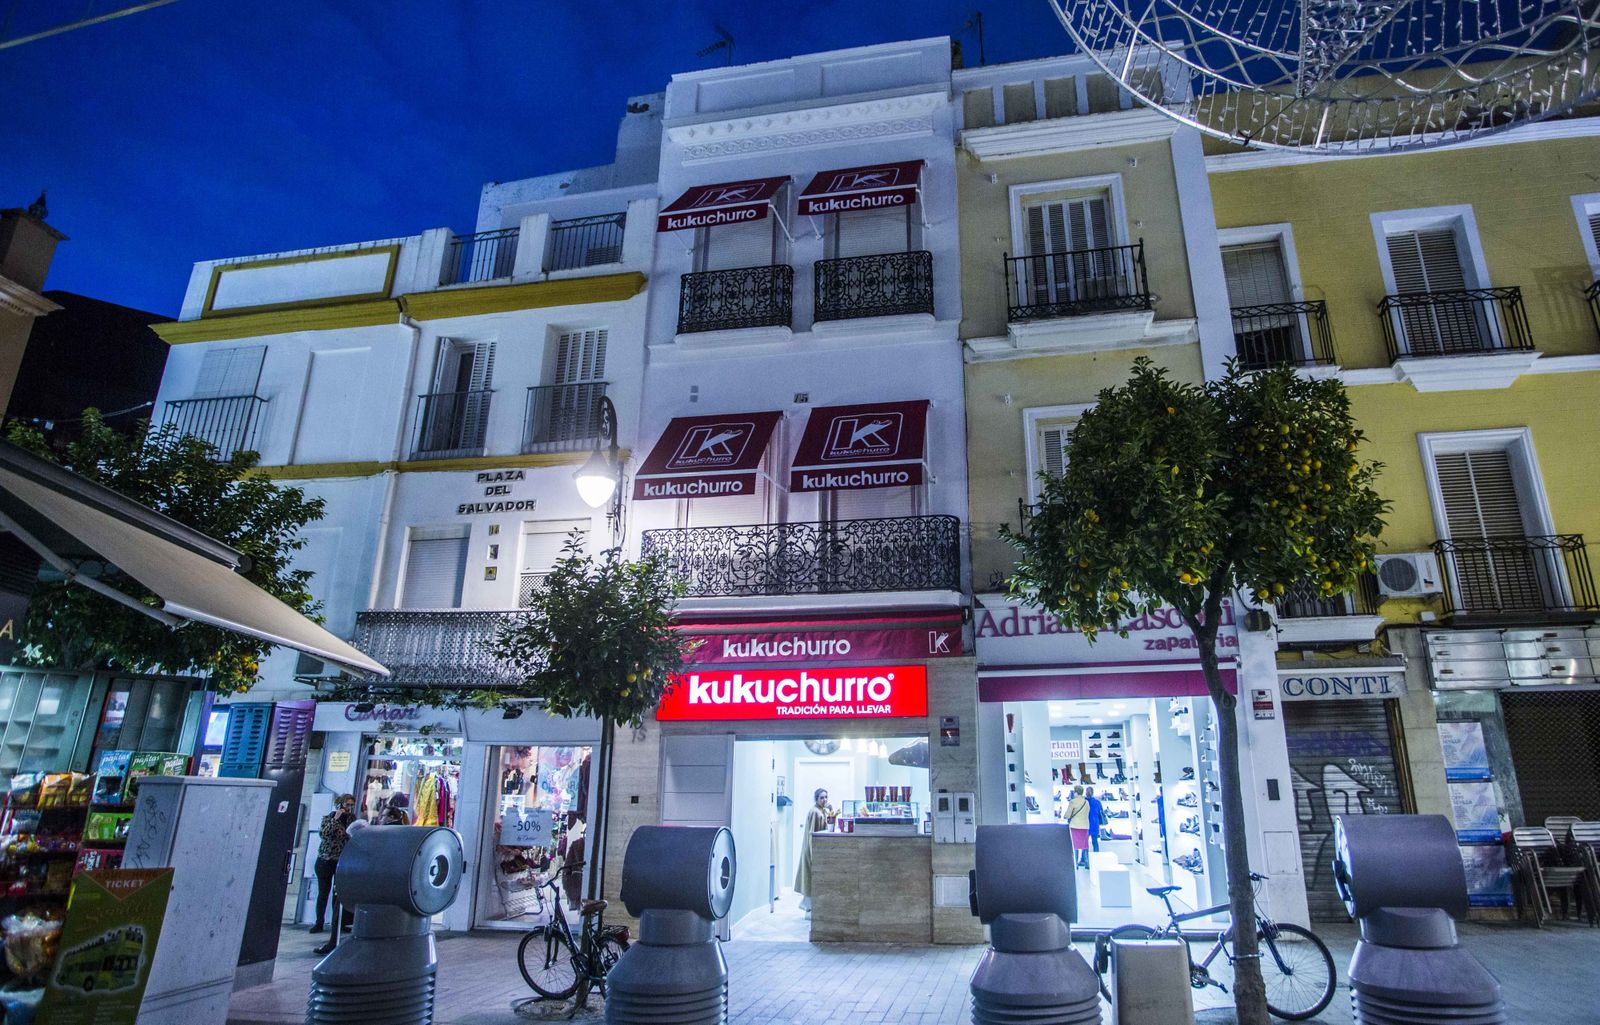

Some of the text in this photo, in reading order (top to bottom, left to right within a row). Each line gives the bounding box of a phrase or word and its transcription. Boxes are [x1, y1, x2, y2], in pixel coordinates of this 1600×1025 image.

[808, 194, 904, 213] kukuchurro
[667, 209, 757, 229] kukuchurro
[477, 470, 524, 482] PLAZA
[803, 471, 909, 489] kukuchurro
[485, 485, 511, 496] DEL
[643, 479, 743, 496] kukuchurro
[458, 500, 535, 514] SALVADOR
[723, 637, 851, 658] kukuchurro
[688, 671, 892, 704] kukuchurro
[1282, 675, 1393, 697] CONTI
[776, 704, 891, 715] TRADICIÓN PARA LLEVAR
[512, 821, 541, 832] -50%
[106, 879, 144, 888] TICKET
